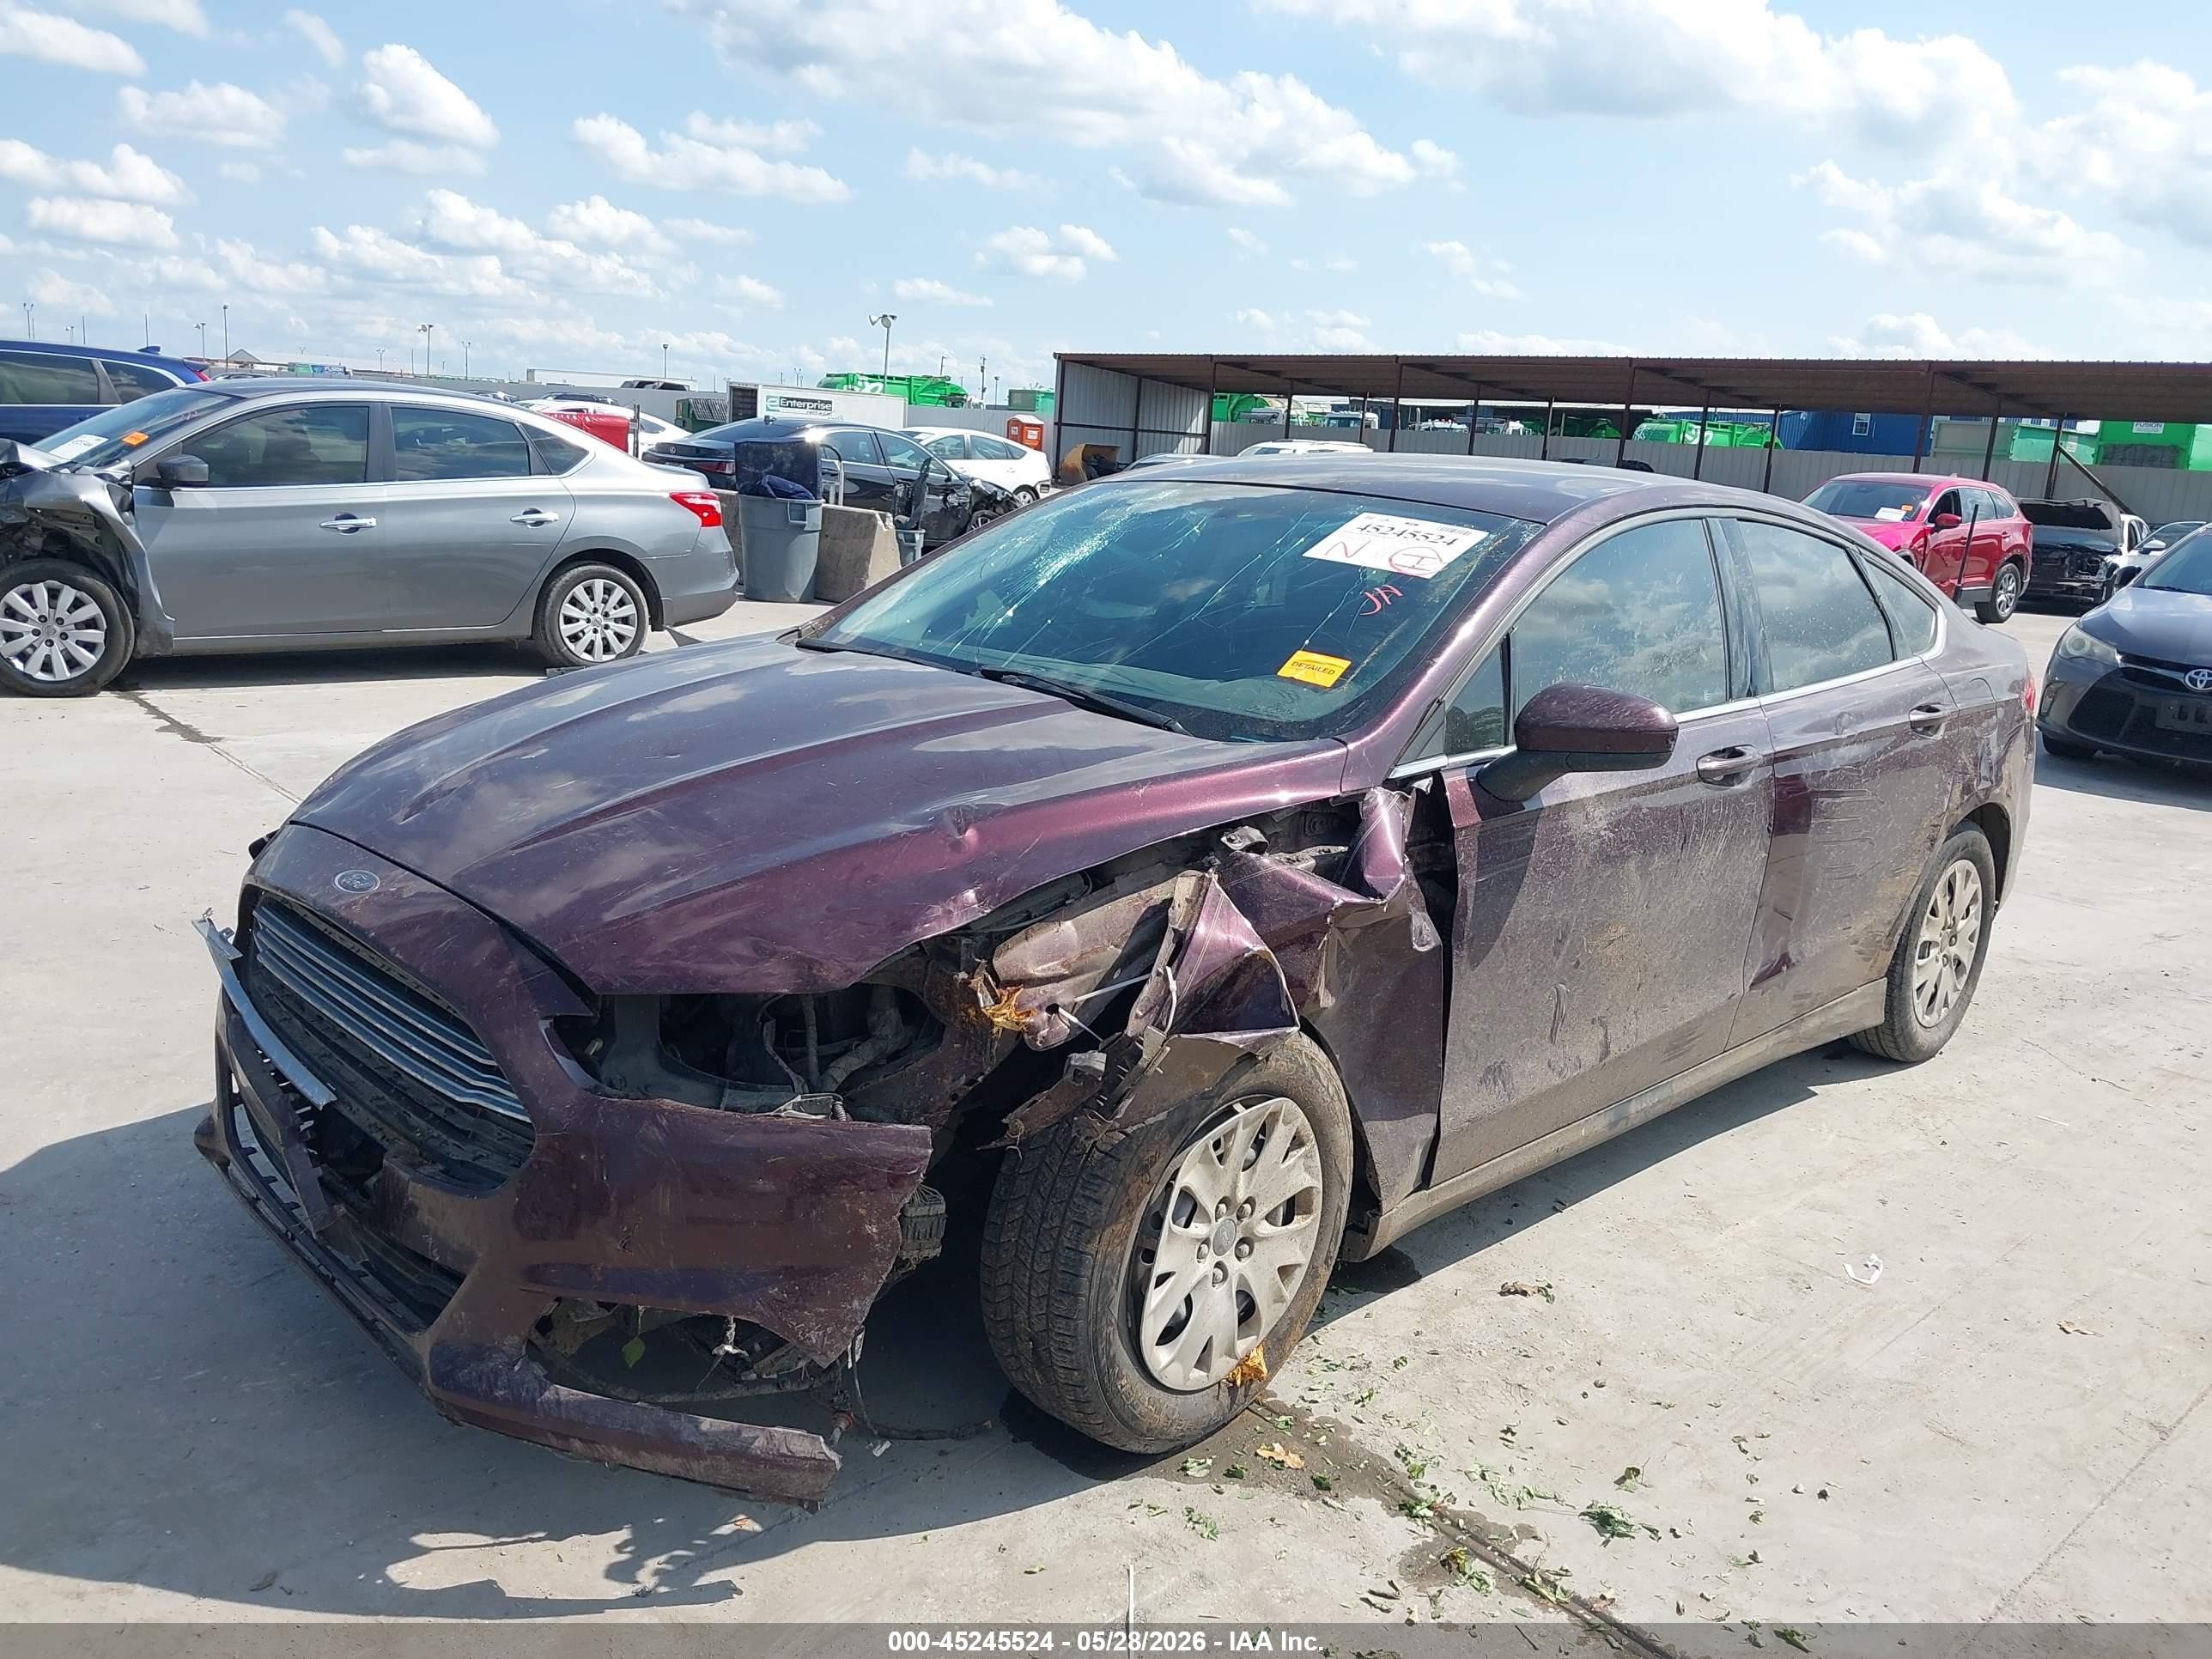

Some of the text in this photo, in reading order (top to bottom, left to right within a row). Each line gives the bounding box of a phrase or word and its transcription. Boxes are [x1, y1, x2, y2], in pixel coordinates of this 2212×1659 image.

[781, 398, 831, 410] Enterprise
[1358, 523, 1459, 546] 45245524
[1325, 539, 1372, 558] N
[1291, 660, 1335, 675] DETAILED
